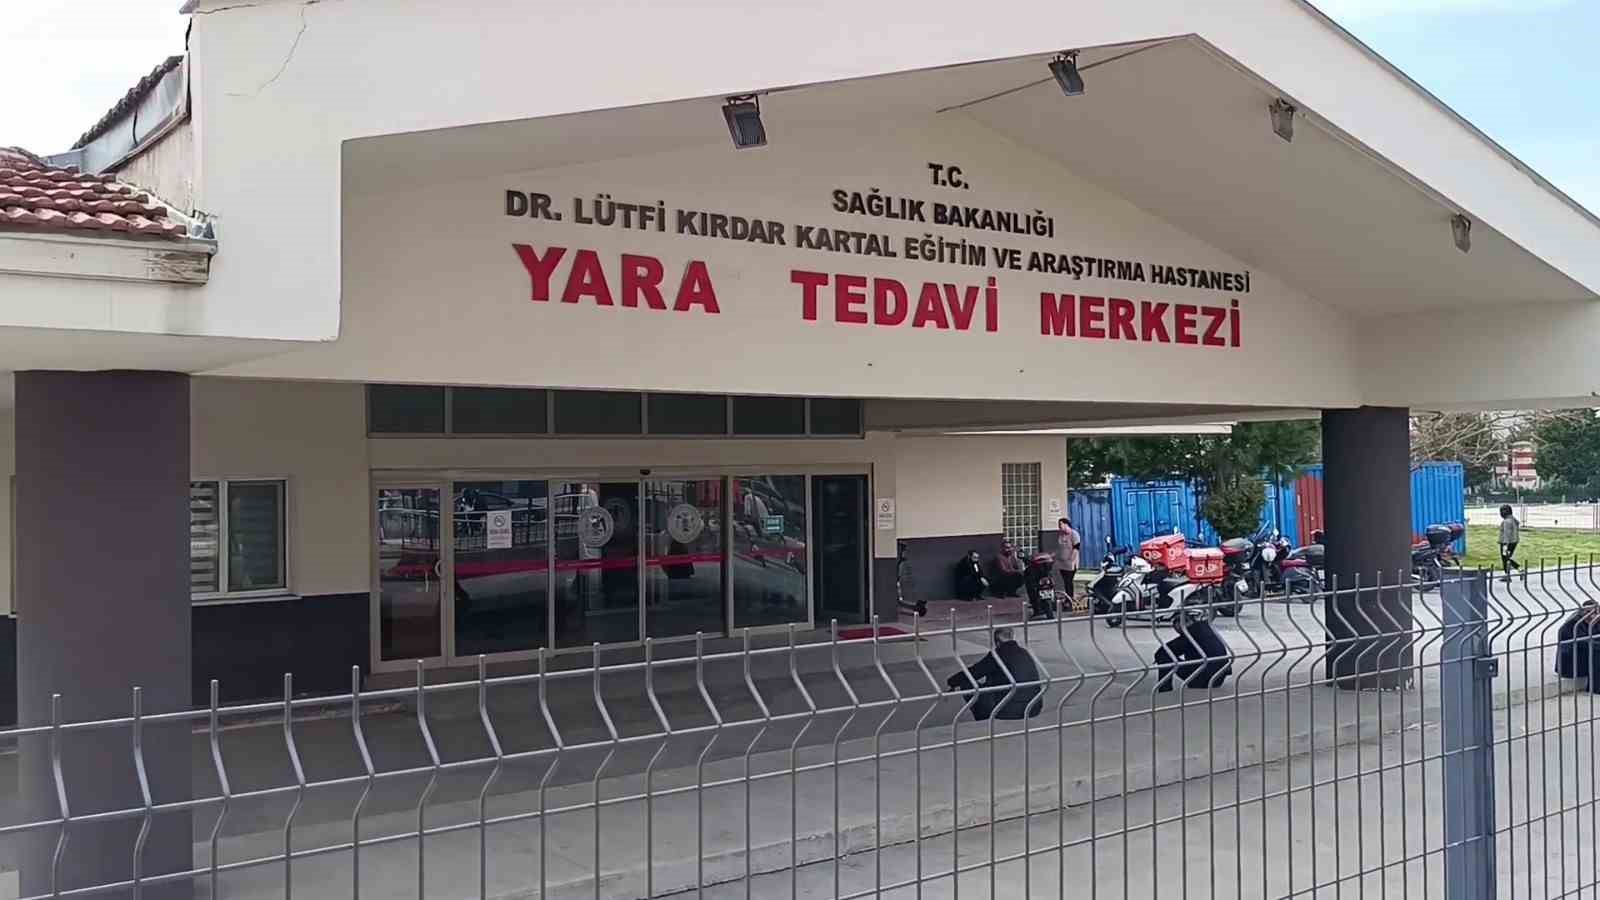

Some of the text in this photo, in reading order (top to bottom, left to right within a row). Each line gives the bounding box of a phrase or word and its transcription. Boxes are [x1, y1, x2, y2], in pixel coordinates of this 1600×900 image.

[832, 187, 1054, 238] SAĞLIK BAKANLIĞI
[928, 162, 969, 190] T.C.
[505, 189, 1250, 294] DR. LÜTFİ KIRDAR KARTAL EĞİTİM VE ARAŞTIRMA HASTANESİ
[512, 243, 1241, 348] YARA TEDAVİ MERKEZİ
